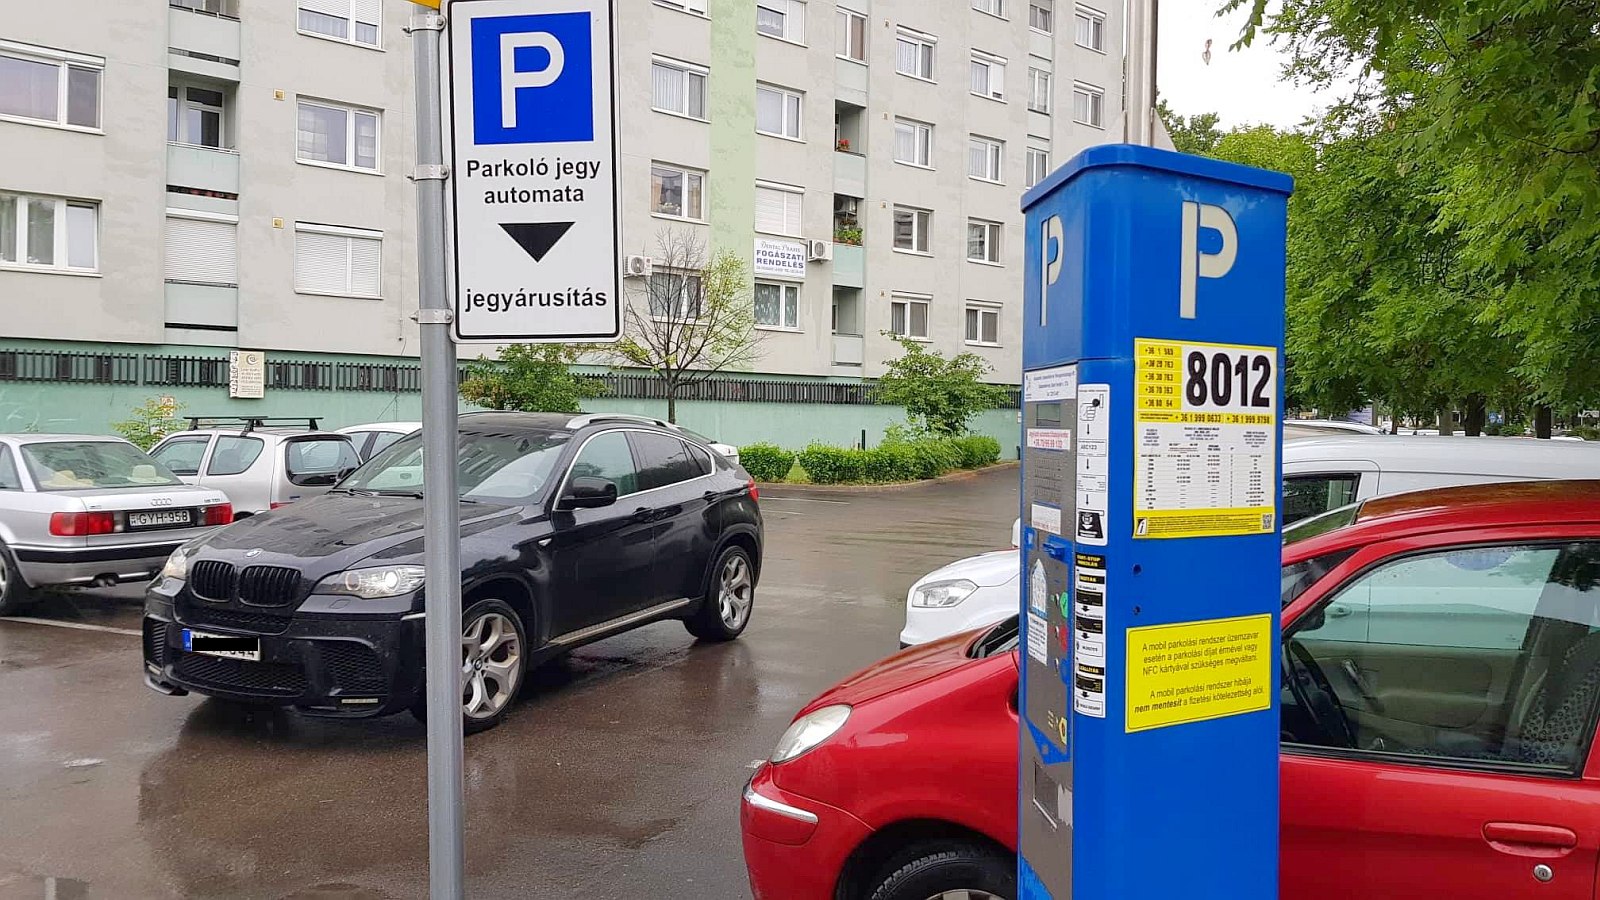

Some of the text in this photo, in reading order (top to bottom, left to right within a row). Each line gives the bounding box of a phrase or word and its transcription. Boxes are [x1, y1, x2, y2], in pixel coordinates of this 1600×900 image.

[500, 31, 565, 128] P
[466, 157, 601, 180] Parkoló jegy
[484, 186, 584, 205] automata
[756, 249, 804, 261] FOGÁSZATI
[756, 258, 804, 269] RENDELÉS
[465, 288, 607, 312] jegyárusítás
[1186, 351, 1271, 407] 8012
[140, 511, 188, 524] GYH-958
[1142, 632, 1260, 652] A mobil parkolási rendszer üzemzavar
[1144, 654, 1166, 664] esetén
[1174, 650, 1203, 662] parkolási
[1219, 644, 1243, 655] érmével
[1244, 644, 1258, 652] vagy
[1142, 666, 1158, 676] NFC
[1160, 662, 1190, 674] kártyával
[1190, 659, 1224, 670] szükséges
[1150, 677, 1252, 700] A mobil parkolási rendszer hibája
[1134, 705, 1150, 714] nem
[1189, 695, 1212, 706] fizetési
[1213, 688, 1252, 700] kötelezettség
